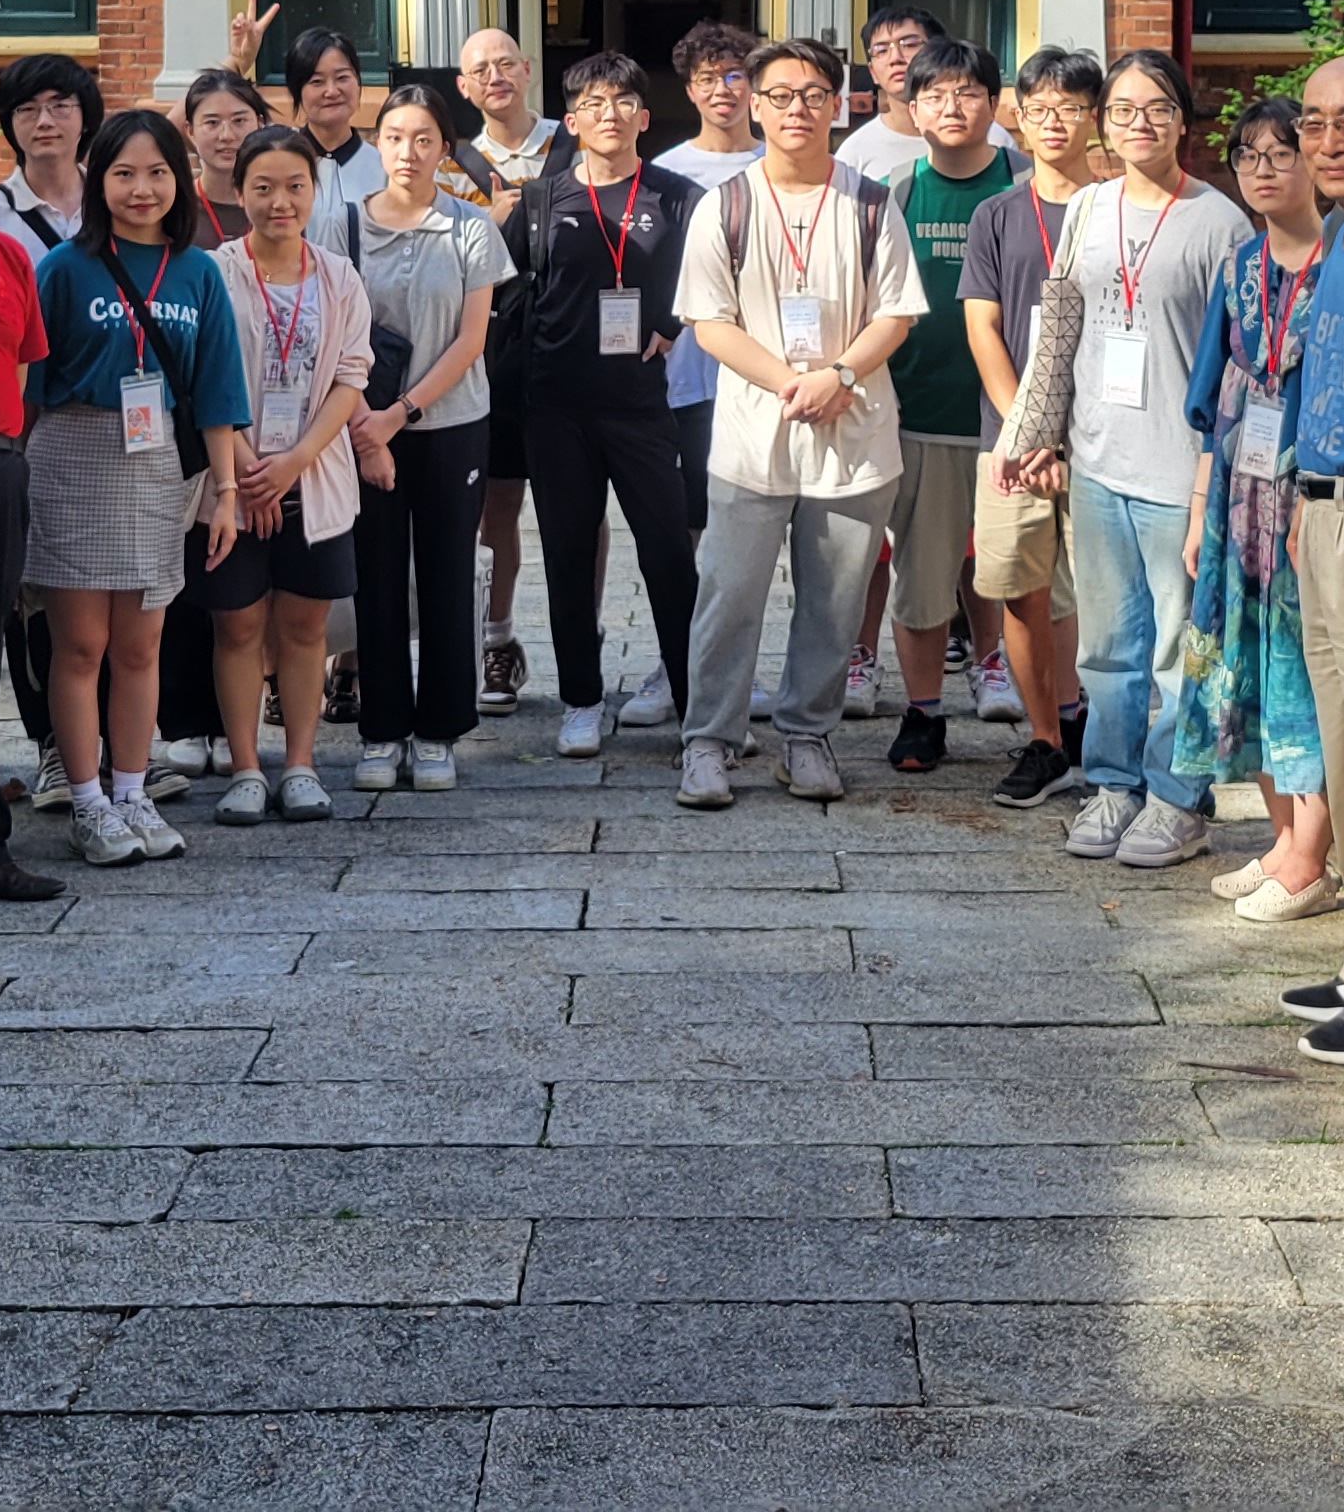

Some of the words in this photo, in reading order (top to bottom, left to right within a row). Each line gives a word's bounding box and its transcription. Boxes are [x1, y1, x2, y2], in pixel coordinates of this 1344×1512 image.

[916, 222, 970, 239] VEGANG
[1127, 237, 1147, 267] Y
[1102, 287, 1143, 305] 194
